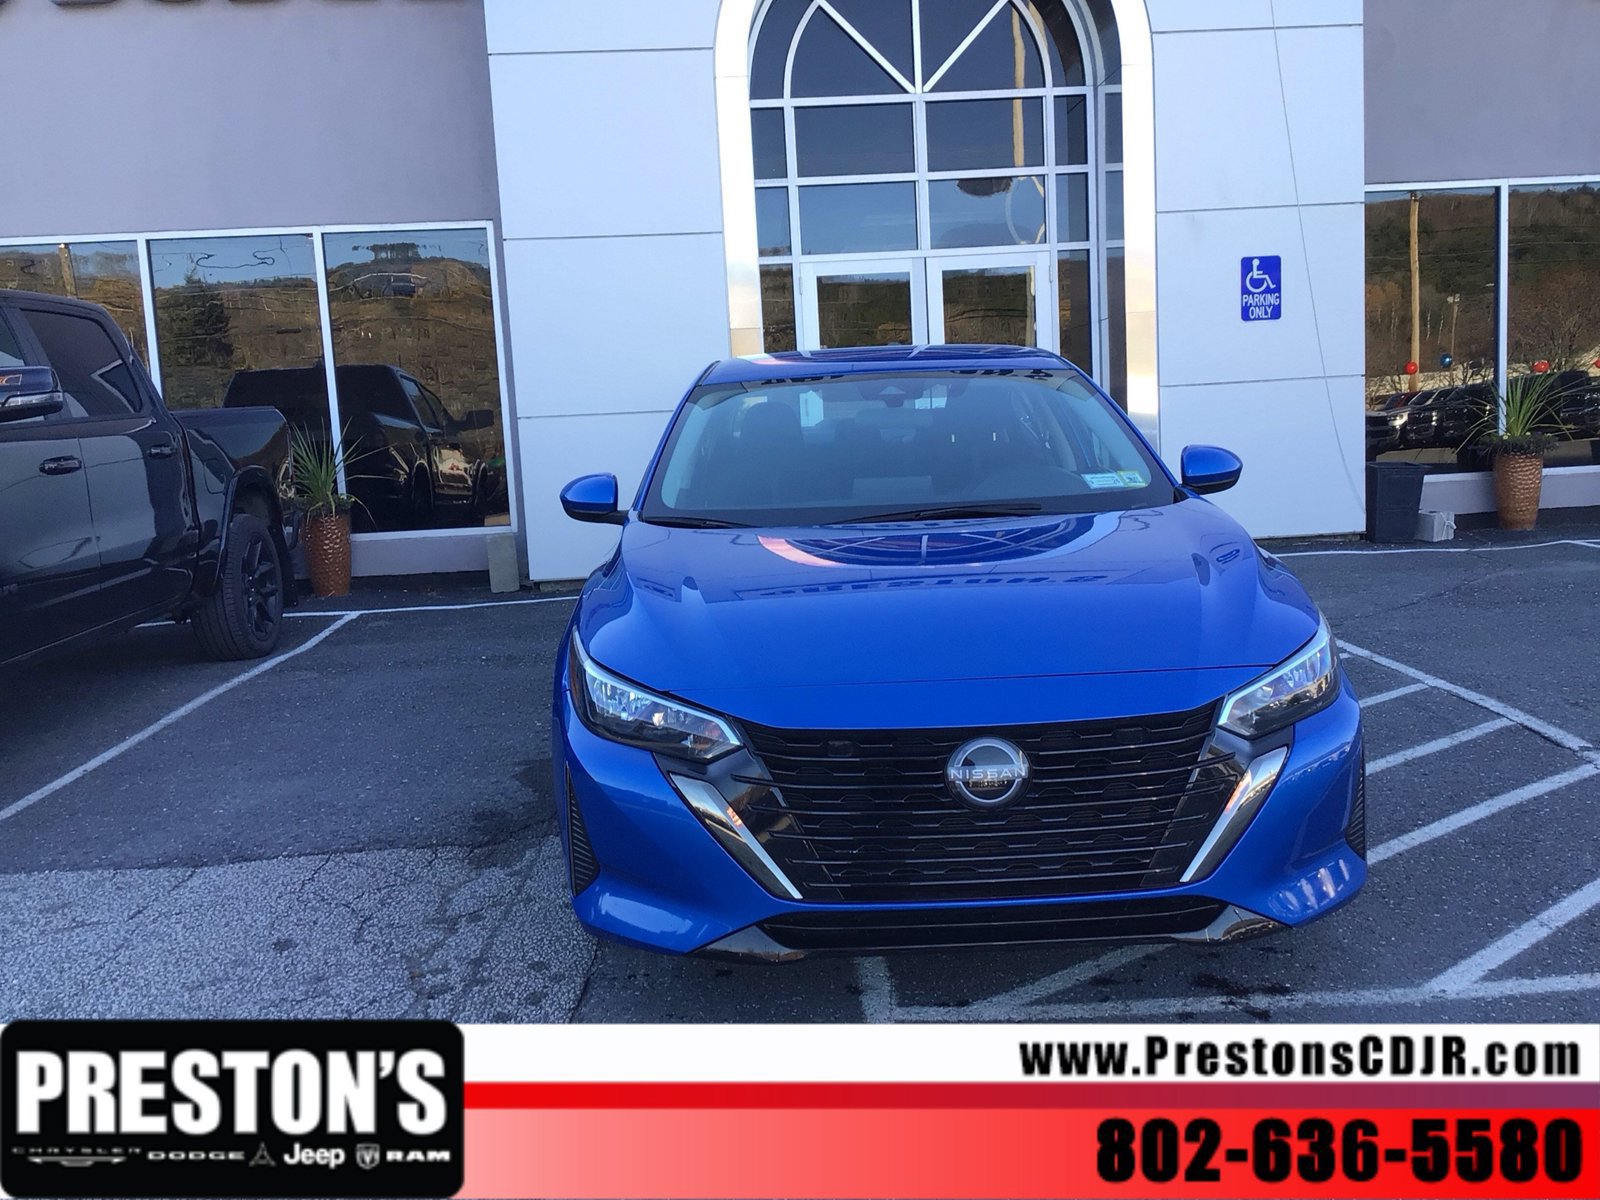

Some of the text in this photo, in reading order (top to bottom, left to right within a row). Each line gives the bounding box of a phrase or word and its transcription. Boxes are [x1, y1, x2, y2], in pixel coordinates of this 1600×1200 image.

[1242, 293, 1280, 307] PARKING
[1249, 305, 1273, 319] ONLY
[950, 767, 1026, 780] NISSAN
